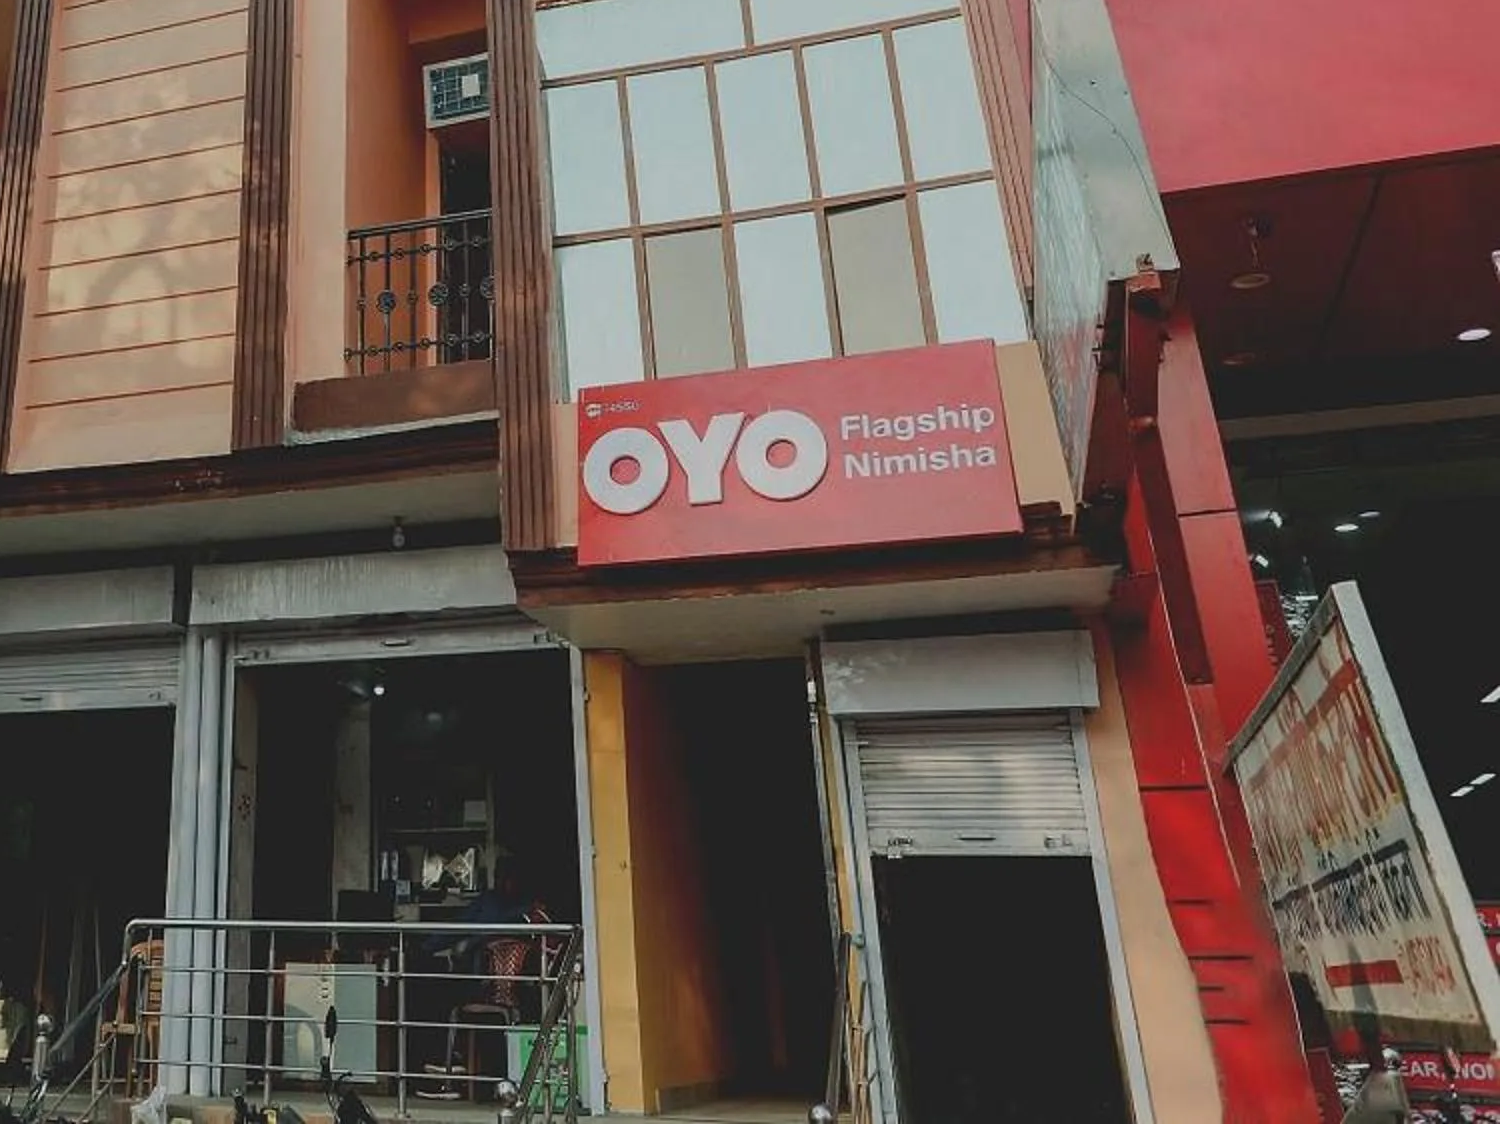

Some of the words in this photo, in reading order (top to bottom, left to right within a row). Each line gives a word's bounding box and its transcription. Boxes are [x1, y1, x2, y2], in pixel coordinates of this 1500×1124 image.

[840, 404, 995, 442] Flagship
[583, 409, 828, 516] OYO
[844, 444, 997, 480] Nimisha
